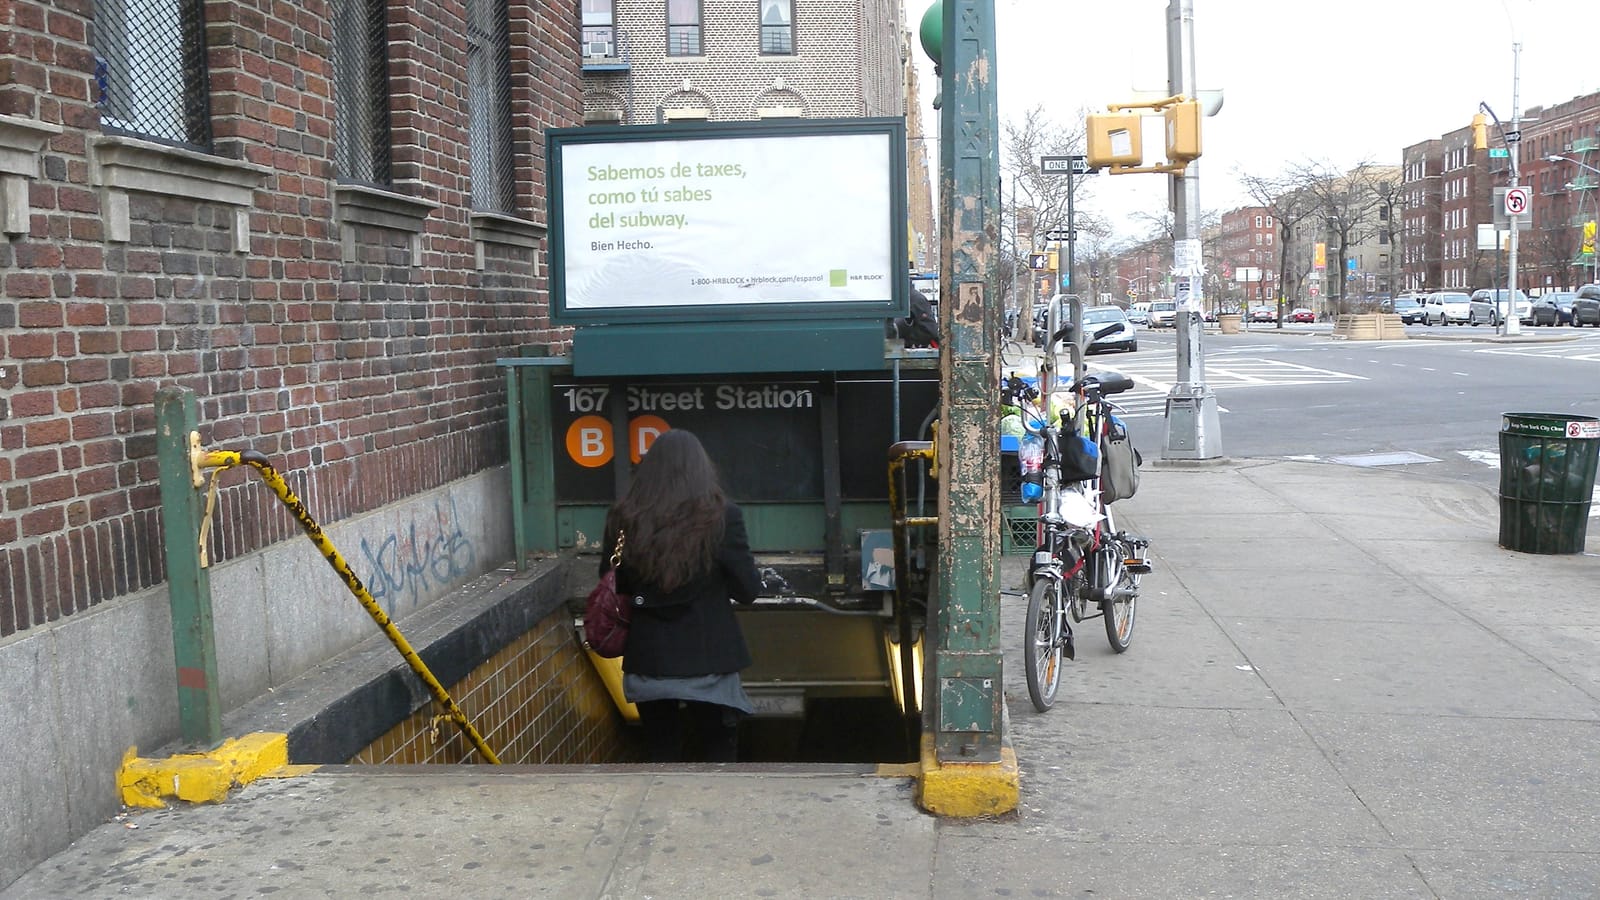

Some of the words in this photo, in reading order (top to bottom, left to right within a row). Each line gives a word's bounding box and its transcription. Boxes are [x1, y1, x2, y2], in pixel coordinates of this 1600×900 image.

[587, 164, 665, 182] Sabemos
[670, 161, 692, 178] de
[696, 162, 747, 179] taxes,
[1048, 161, 1066, 169] ONE
[588, 190, 636, 205] como
[640, 186, 658, 203] tú
[664, 185, 712, 202] sabes
[589, 212, 615, 229] del
[619, 211, 689, 230] subway.
[591, 241, 614, 251] Bien
[617, 240, 654, 250] Hecho.
[691, 277, 745, 286] 1-800-HRBLOCK
[563, 387, 609, 412] 167
[626, 386, 705, 412] Street
[716, 384, 813, 409] Station
[581, 428, 605, 457] B
[638, 427, 661, 455] D
